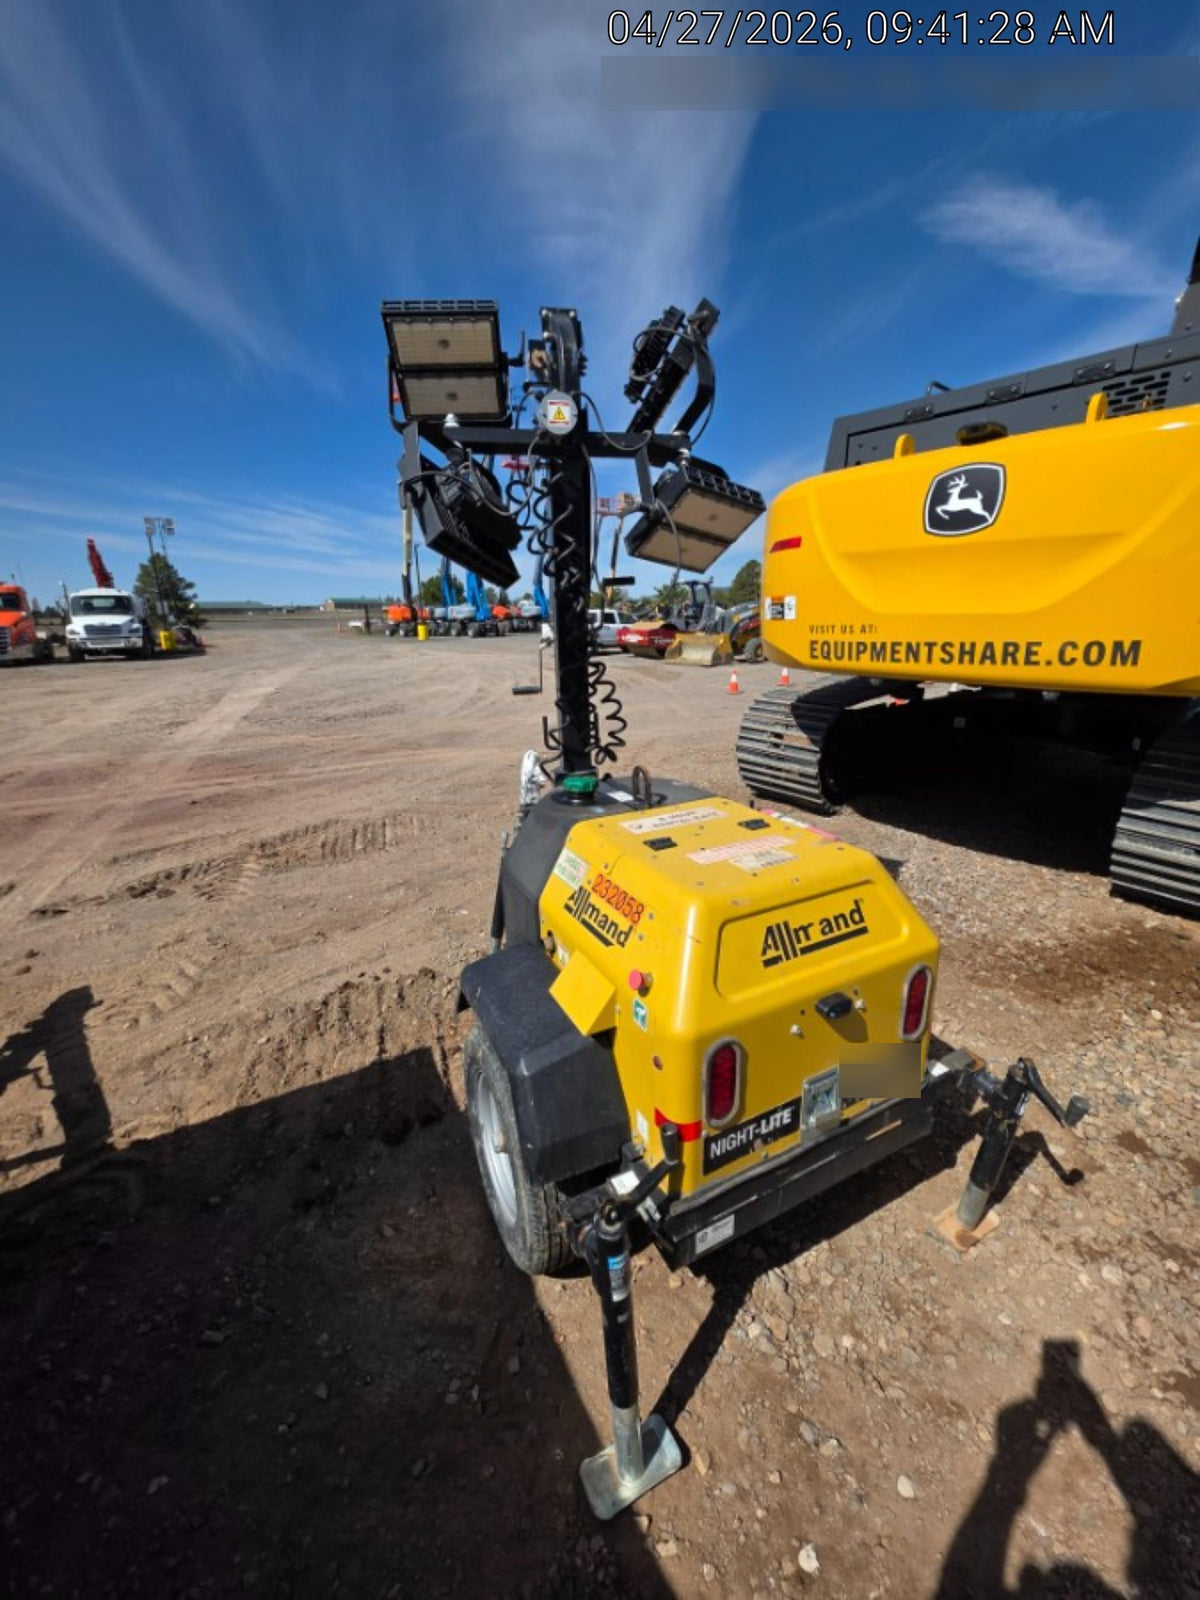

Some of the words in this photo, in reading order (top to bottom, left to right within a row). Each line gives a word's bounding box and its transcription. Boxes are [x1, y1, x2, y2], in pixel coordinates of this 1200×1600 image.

[808, 624, 836, 635] VISIT
[840, 624, 854, 635] US
[809, 639, 1142, 667] EQUIPMENTSHARE.COM
[564, 886, 634, 948] Allmand
[710, 1107, 792, 1159] NIGHT-LITE
